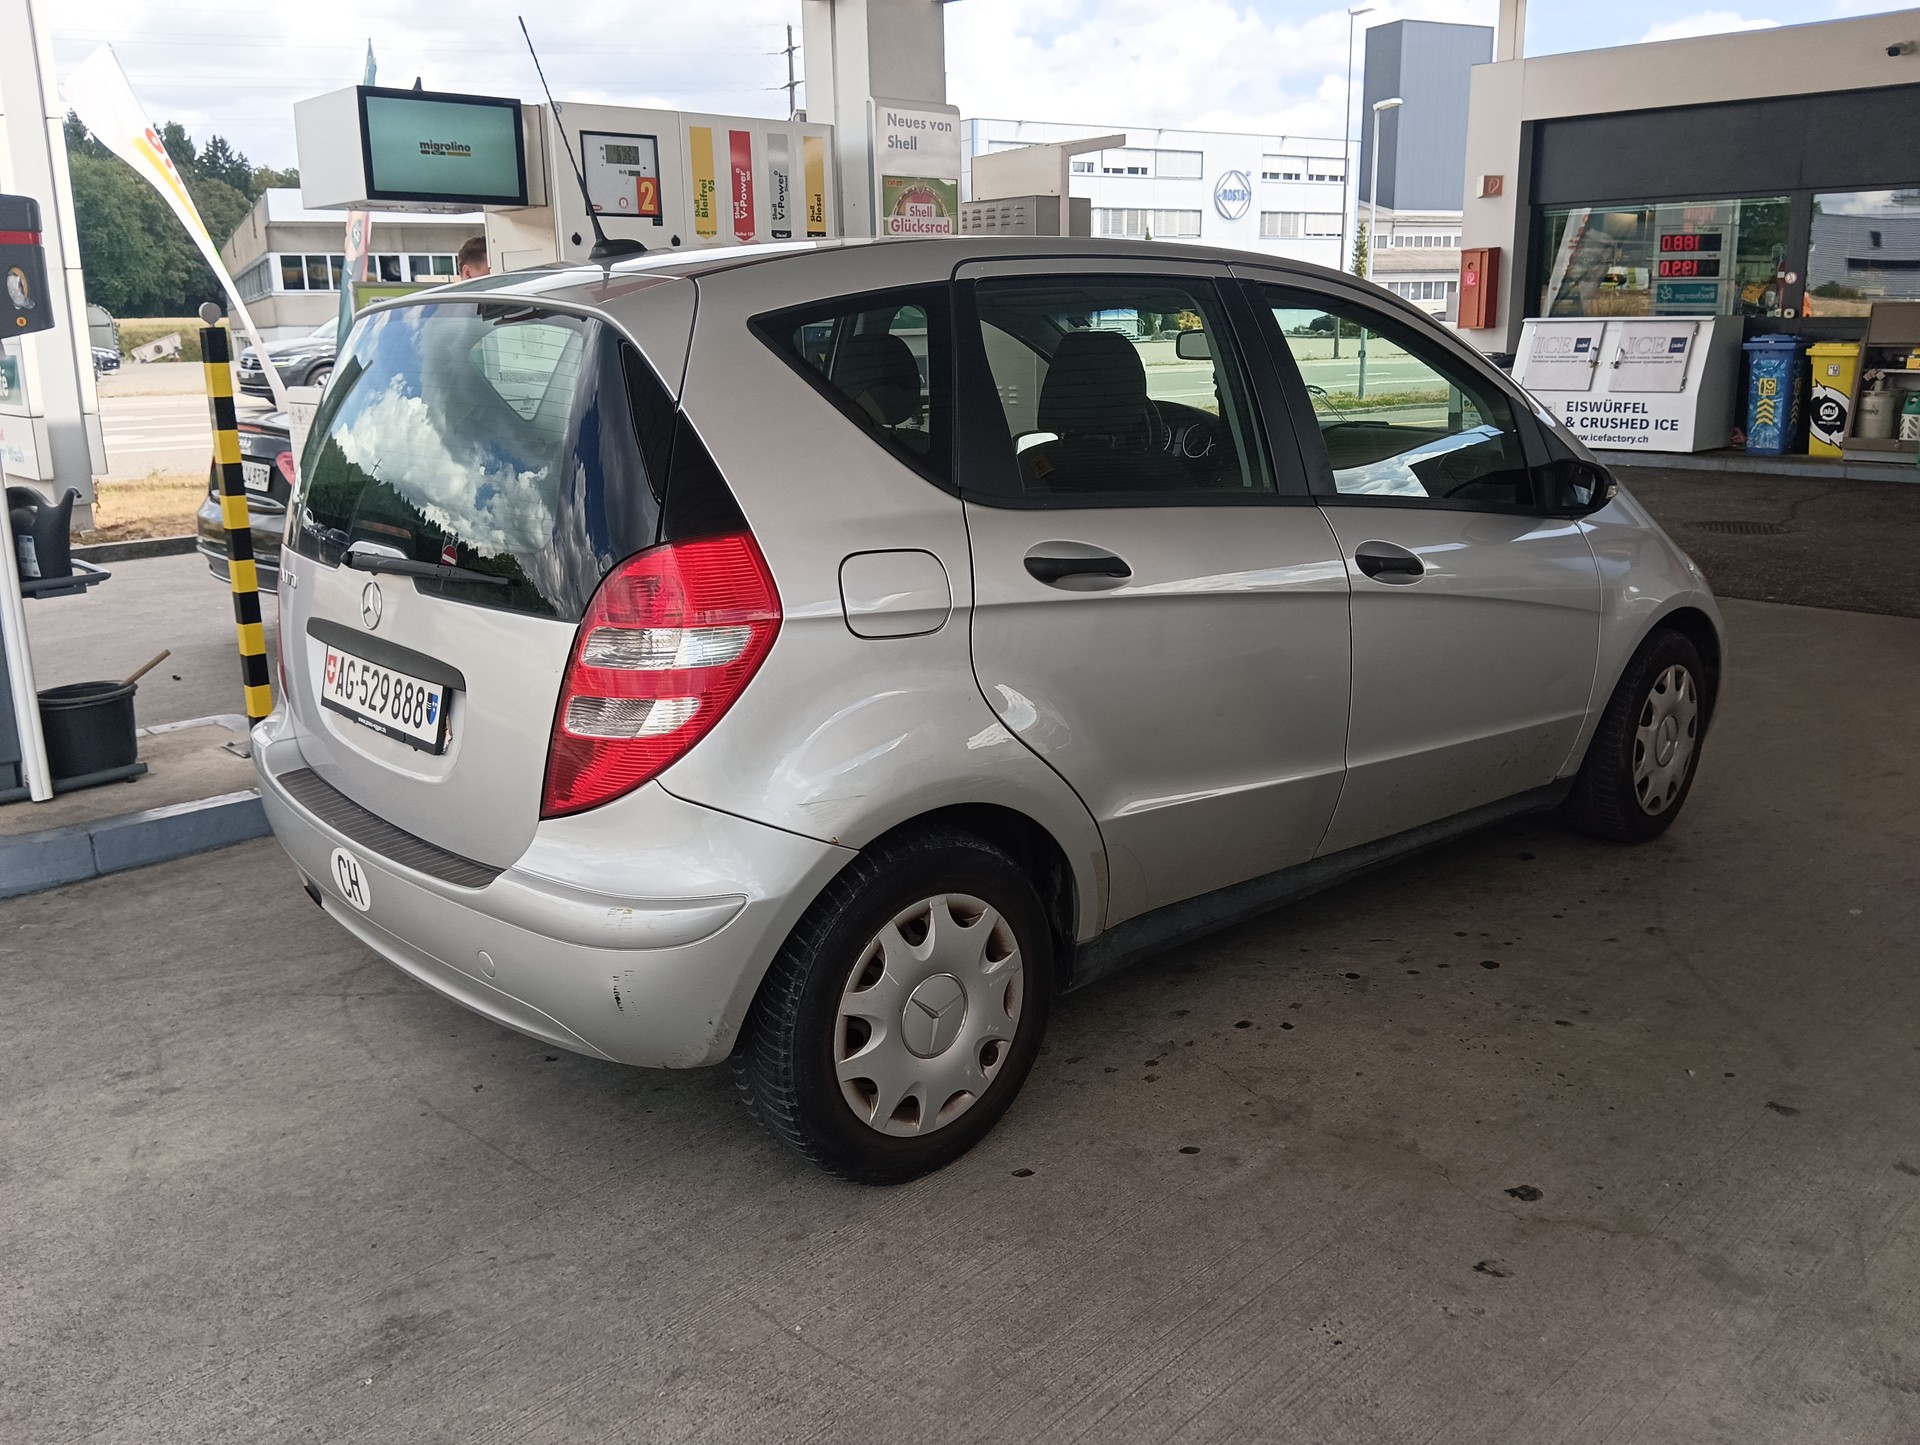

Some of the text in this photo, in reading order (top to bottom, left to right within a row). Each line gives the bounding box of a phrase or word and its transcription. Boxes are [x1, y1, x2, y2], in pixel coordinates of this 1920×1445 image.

[887, 112, 952, 132] Neues von
[419, 139, 471, 153] migrolino
[887, 134, 917, 151] Shell
[707, 179, 715, 192] 95
[640, 181, 655, 211] 2
[699, 178, 709, 218] Bleifrei
[739, 170, 748, 219] V-Power
[777, 172, 785, 220] V-Power
[1222, 189, 1245, 201] ROSTA
[814, 193, 822, 223] Diesel
[909, 205, 933, 218] Shell
[890, 217, 950, 234] Glücksrad
[1534, 336, 1573, 354] ICE
[1629, 336, 1666, 354] ICE
[1566, 399, 1649, 414] EISWÜRFEL
[1823, 407, 1835, 415] alu
[1565, 416, 1679, 431] & CRUSHED ICE
[1575, 433, 1649, 444] w.icefactory.ch
[337, 854, 365, 906] CH
